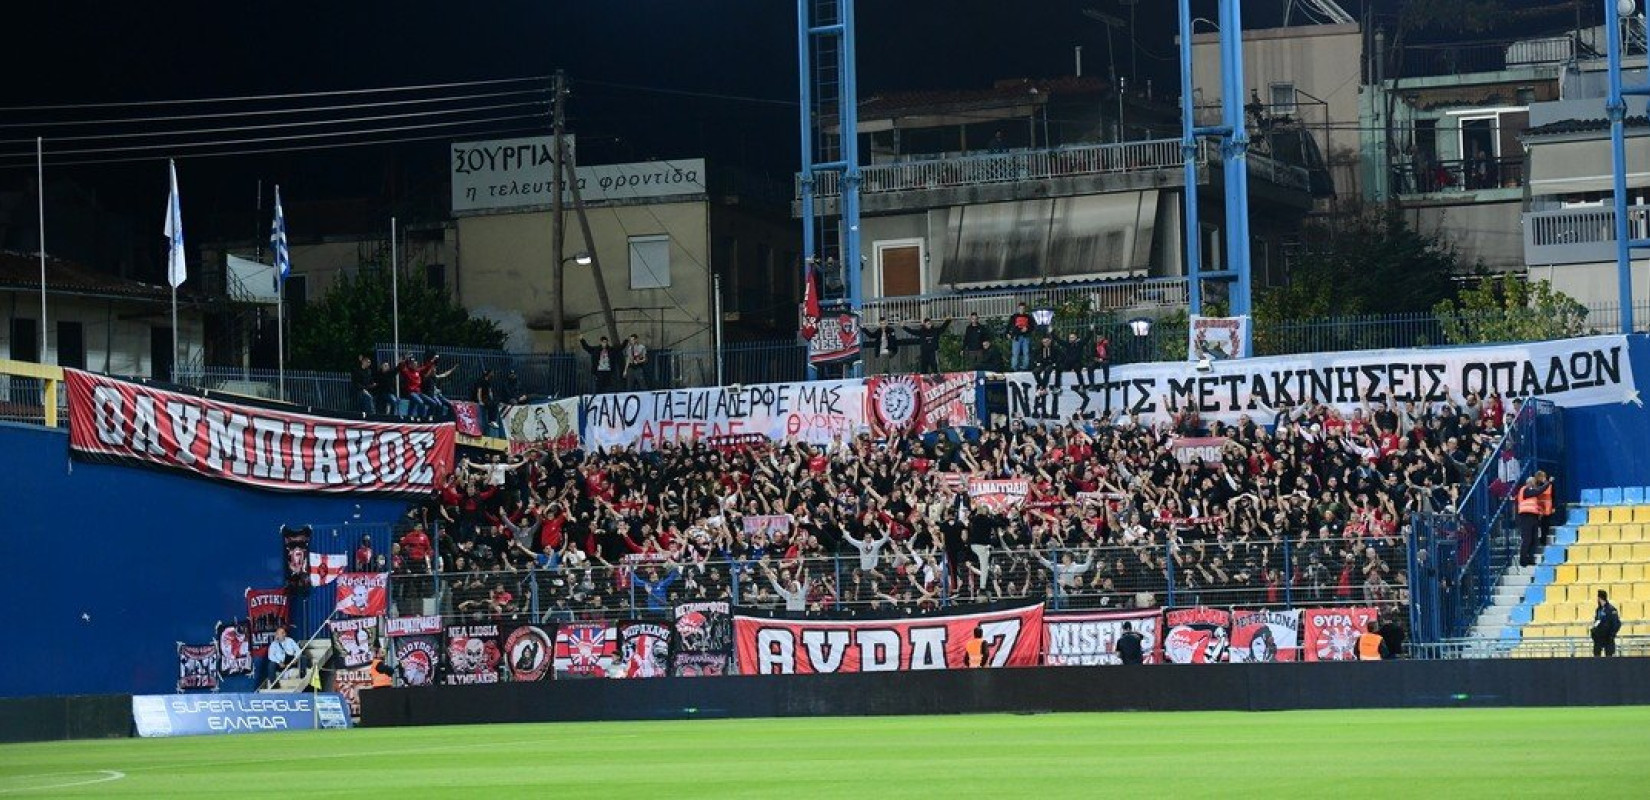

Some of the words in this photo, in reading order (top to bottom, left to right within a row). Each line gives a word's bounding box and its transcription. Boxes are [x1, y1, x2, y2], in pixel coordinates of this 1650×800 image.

[465, 186, 477, 199] η
[600, 168, 699, 191] φροντίδα
[1167, 363, 1447, 412] ΜΕΤΑΚΙΝΗΣΕΙΣ
[1462, 346, 1621, 400] ΟΠΑΔΩΝ
[797, 385, 844, 414] ΜΑΣ
[94, 385, 436, 485] ΟΛΥΜΠΙΑΚΟΣ
[331, 616, 377, 632] PERISTERI
[1313, 615, 1352, 627] ΘΥΡΑ
[1360, 614, 1369, 627] 7
[448, 626, 468, 638] NEA
[172, 699, 235, 713] SUPER
[238, 699, 312, 712] LEAGUE
